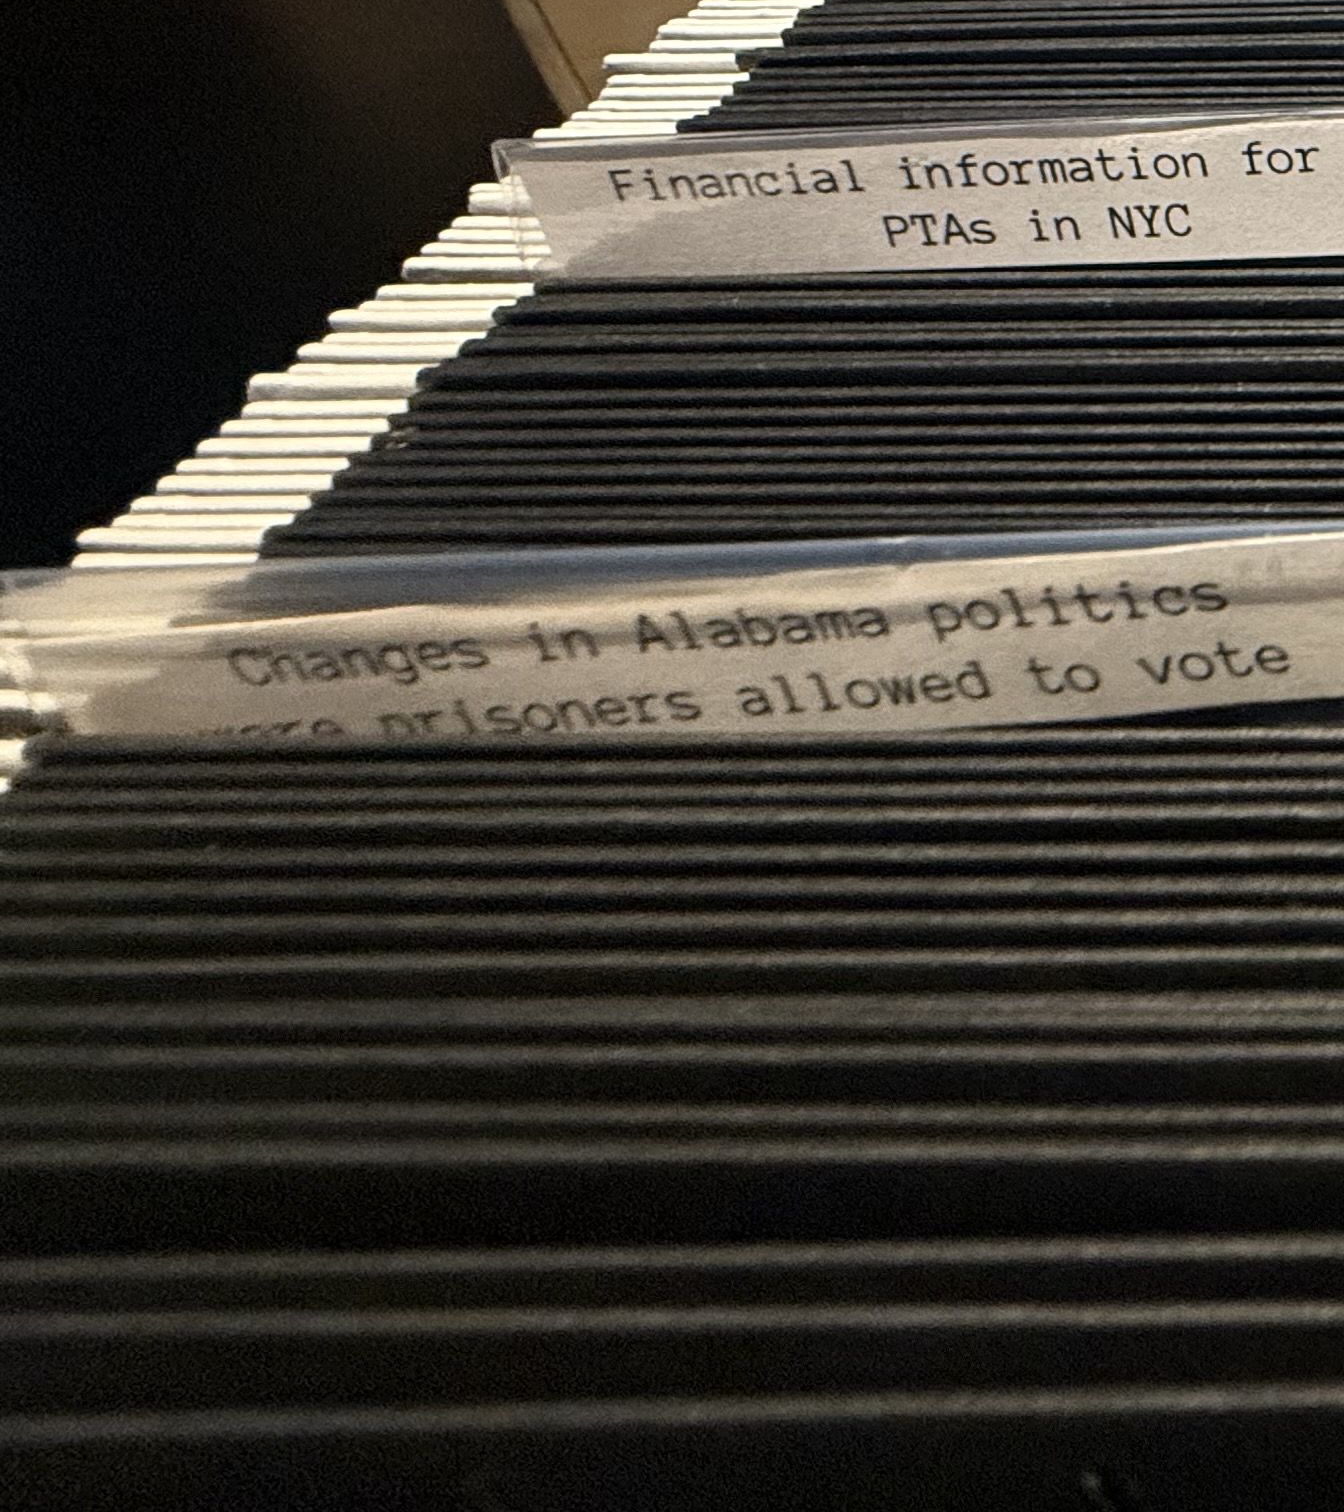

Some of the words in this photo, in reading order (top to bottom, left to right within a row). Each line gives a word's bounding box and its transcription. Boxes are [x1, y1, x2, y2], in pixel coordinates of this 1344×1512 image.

[608, 160, 865, 201] Financial
[899, 147, 1208, 189] information
[1242, 141, 1319, 175] for
[883, 213, 996, 247] PTAs
[1029, 209, 1081, 241] in
[1108, 204, 1191, 238] NYC
[227, 637, 490, 686] Changes
[530, 622, 599, 662] in
[635, 607, 890, 654] Alabama
[926, 575, 1231, 644] politics
[376, 691, 703, 735] prisoners
[735, 660, 993, 717] allowed
[1029, 653, 1103, 696] to
[1137, 641, 1292, 686] vote
